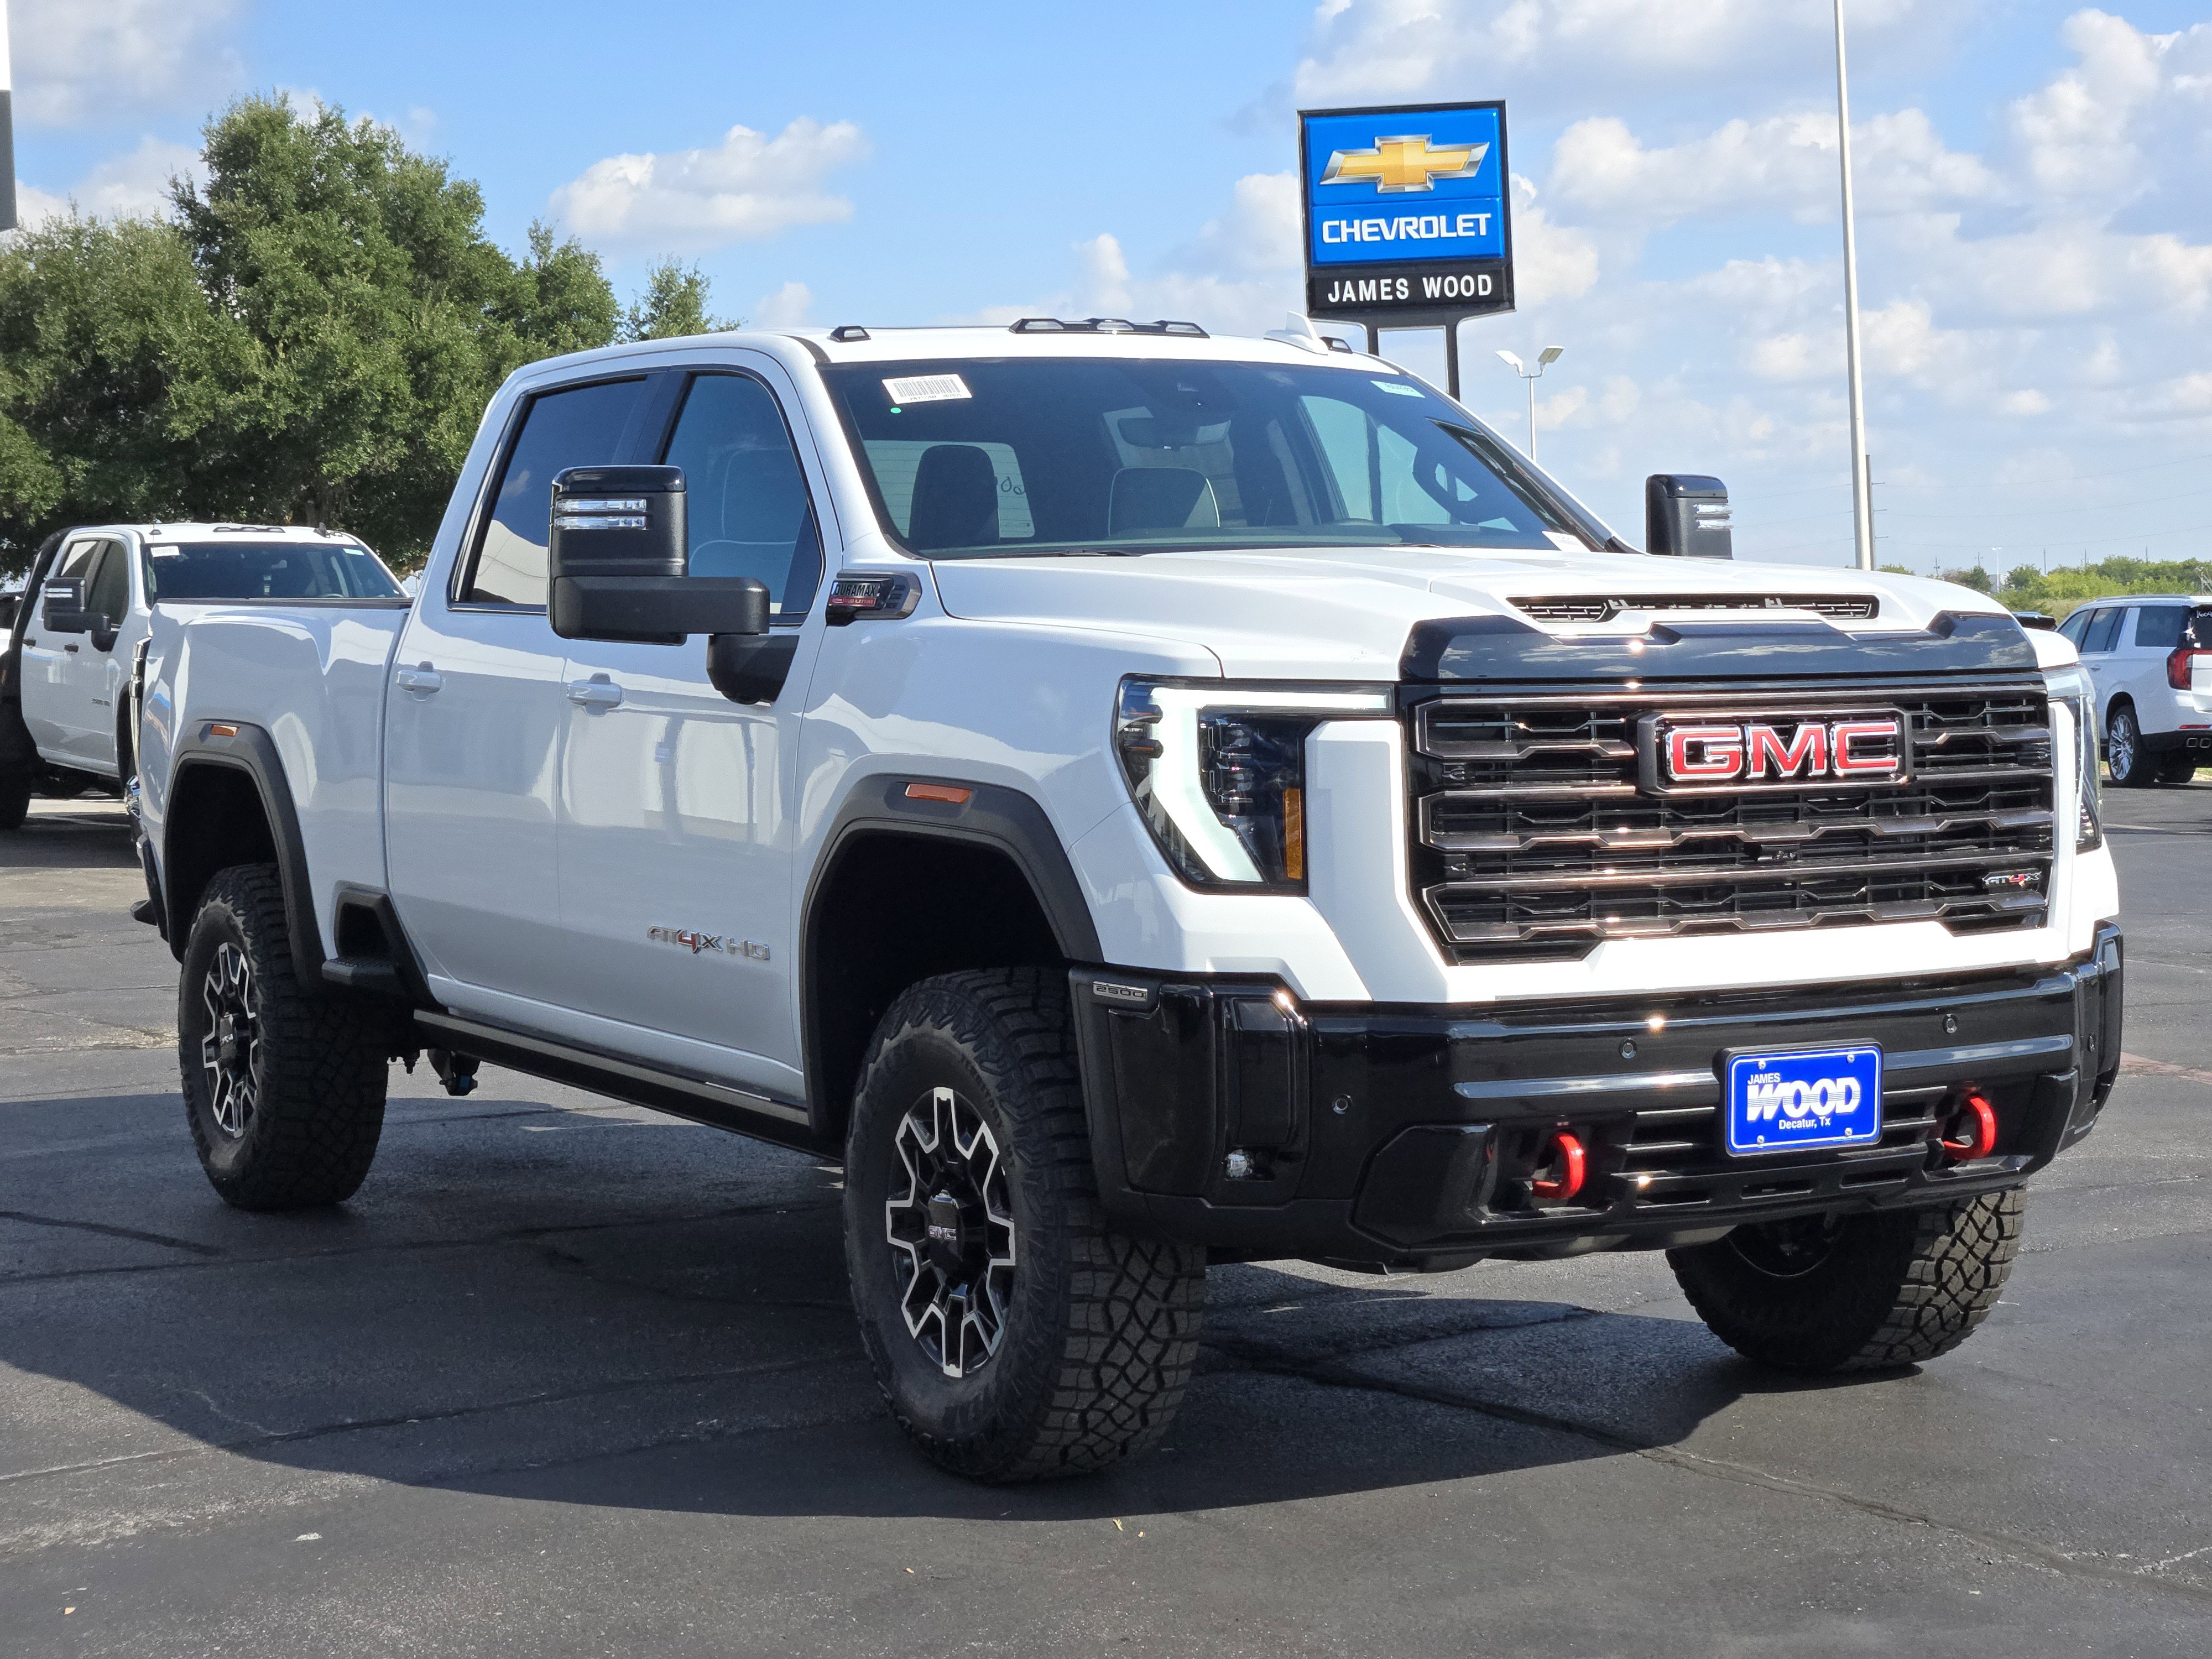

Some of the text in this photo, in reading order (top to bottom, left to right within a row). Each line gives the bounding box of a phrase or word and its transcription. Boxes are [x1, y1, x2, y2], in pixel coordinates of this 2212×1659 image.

[1322, 213, 1491, 243] CHEVROLET
[1328, 274, 1493, 302] JAMES WOOD
[834, 584, 877, 597] DURAMAX
[1666, 722, 1899, 780] GMC
[646, 924, 770, 961] AT4X HD
[1096, 985, 1144, 998] 2500
[1747, 1073, 1781, 1084] JAMES
[1746, 1077, 1861, 1121] WOOD
[1779, 1116, 1831, 1130] Decatur, Tx
[928, 1225, 957, 1241] GMC
